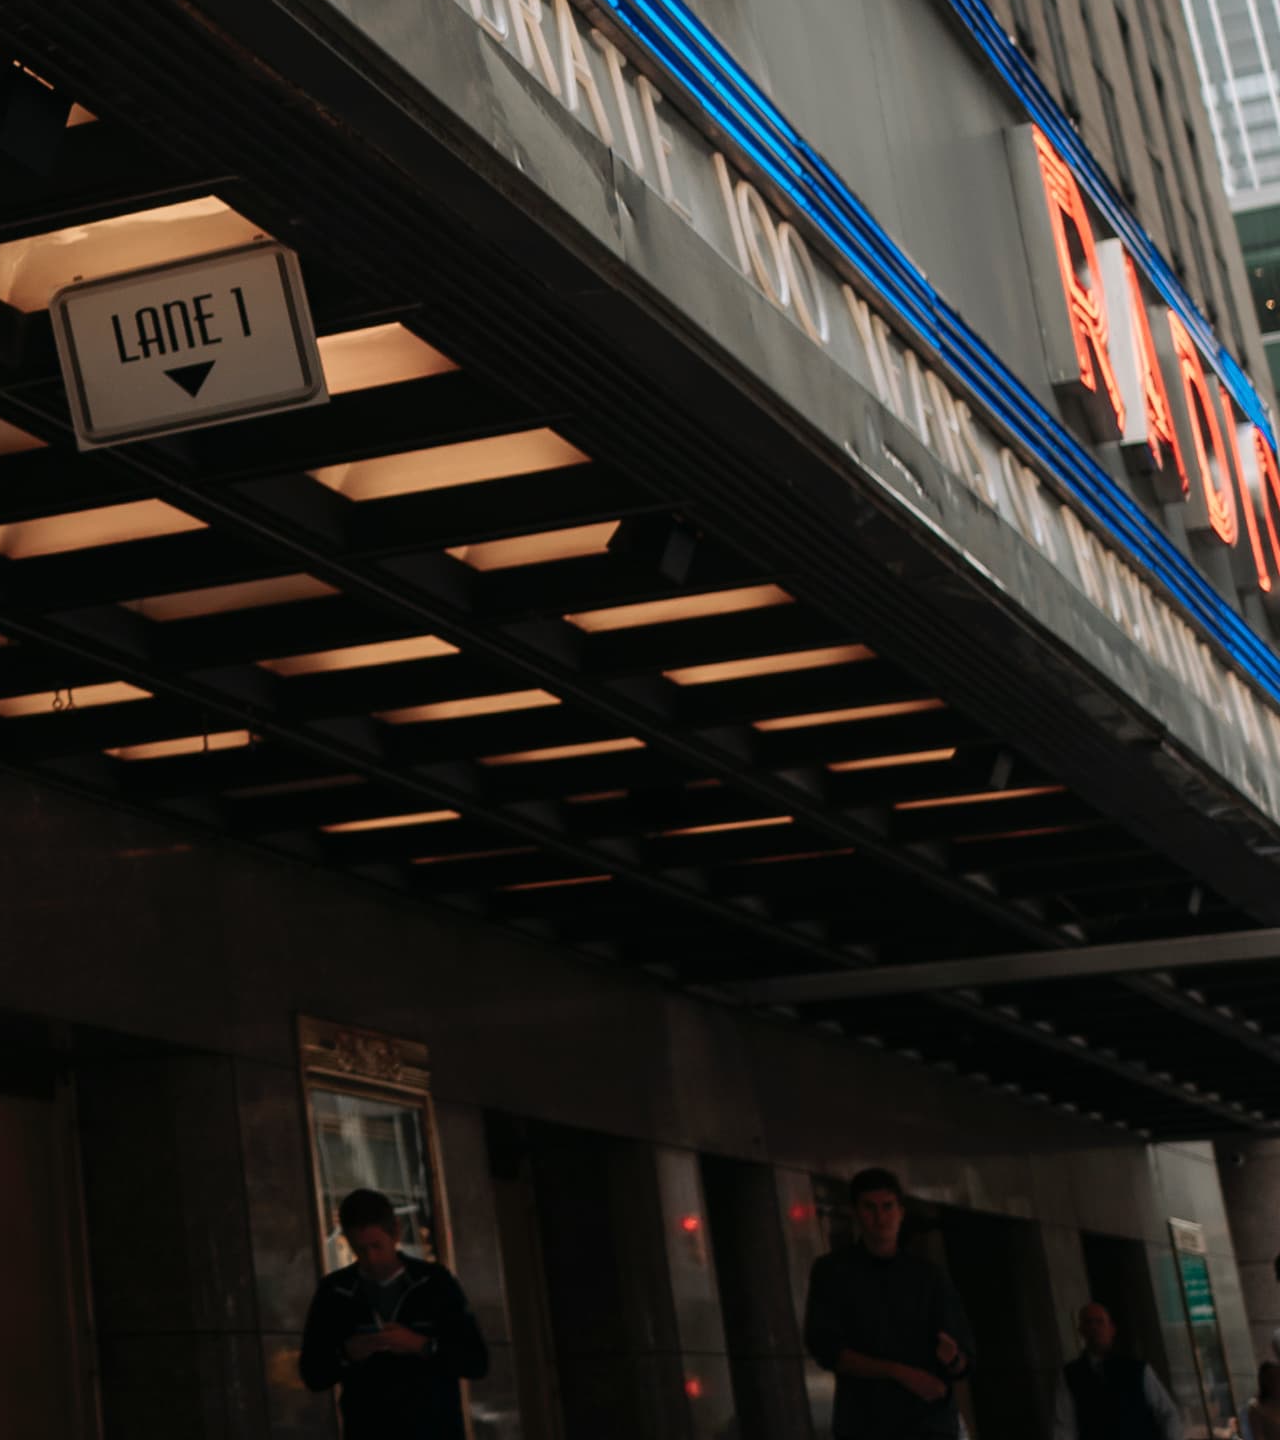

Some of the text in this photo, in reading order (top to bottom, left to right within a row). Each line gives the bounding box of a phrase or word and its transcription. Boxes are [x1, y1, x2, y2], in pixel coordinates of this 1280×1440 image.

[112, 287, 252, 364] LANE 1
[712, 151, 829, 346] 100
[842, 283, 998, 508] YEARS
